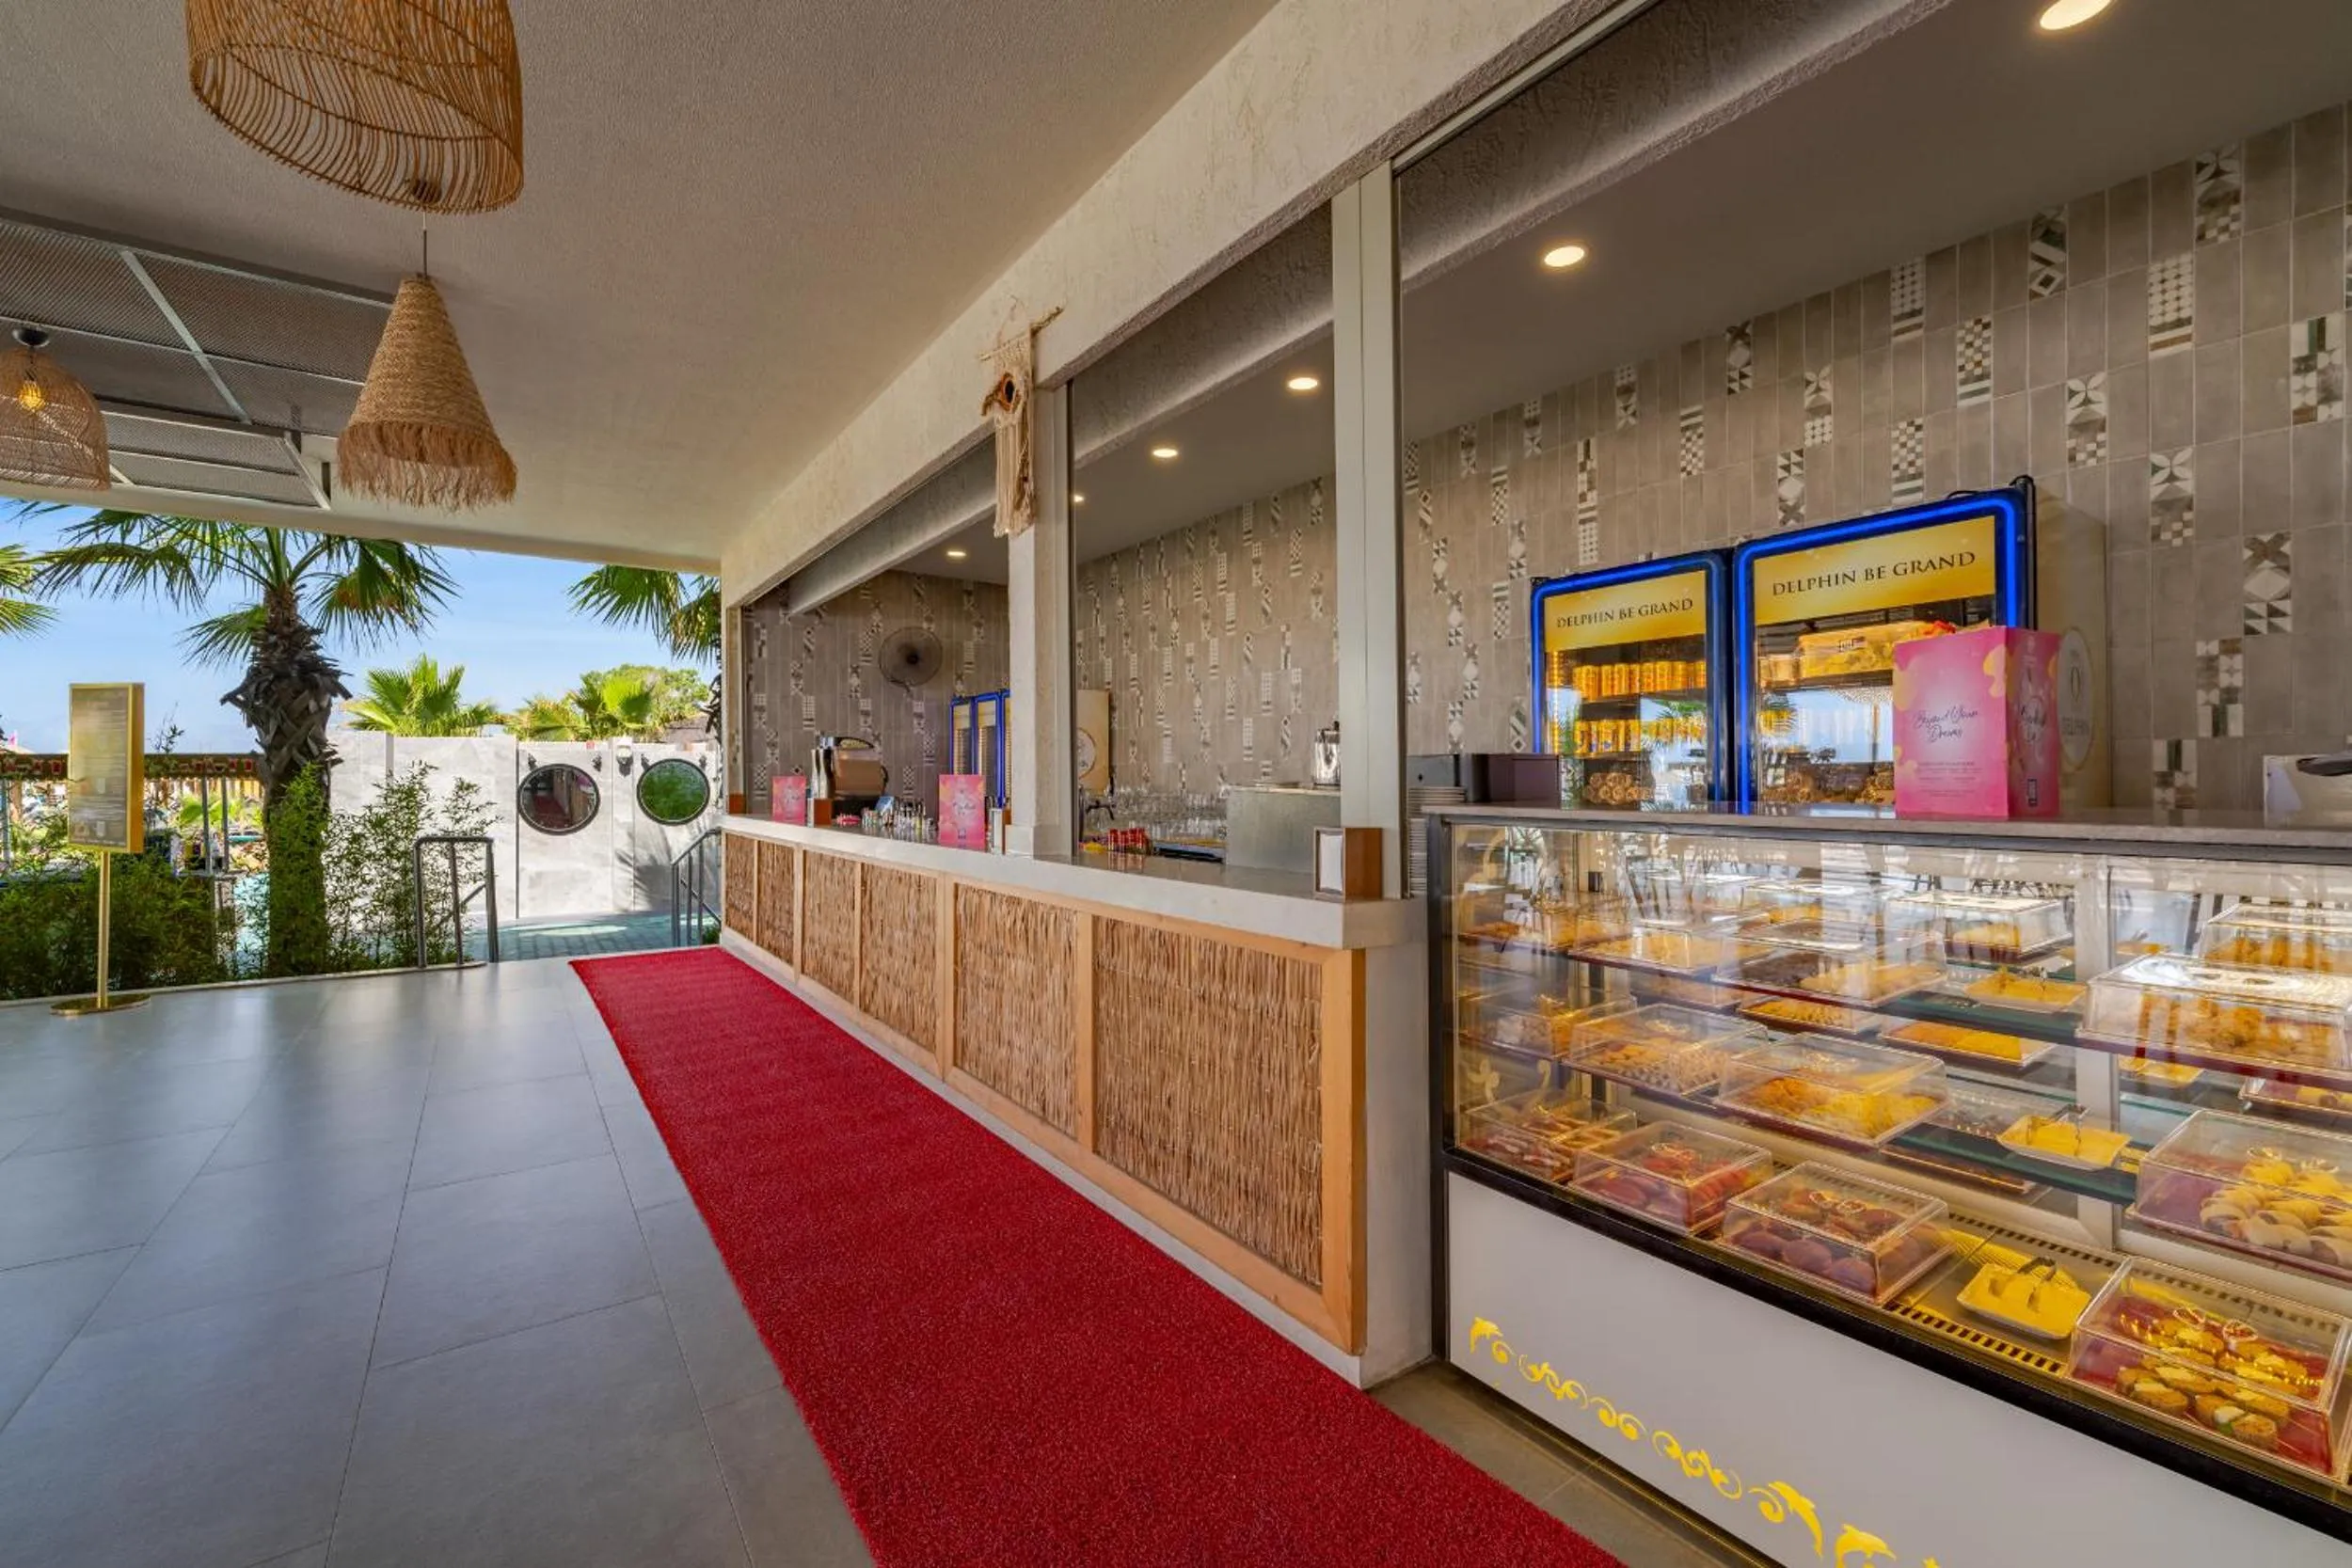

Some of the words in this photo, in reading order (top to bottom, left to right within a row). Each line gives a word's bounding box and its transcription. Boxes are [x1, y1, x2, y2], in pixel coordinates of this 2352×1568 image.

[1772, 570, 1856, 596] DELPHIN
[1864, 565, 1887, 581] BE
[1892, 551, 1976, 577] GRAND
[1556, 610, 1614, 628] DELPHIN
[1618, 607, 1635, 620] BE
[1638, 597, 1693, 617] GRAND
